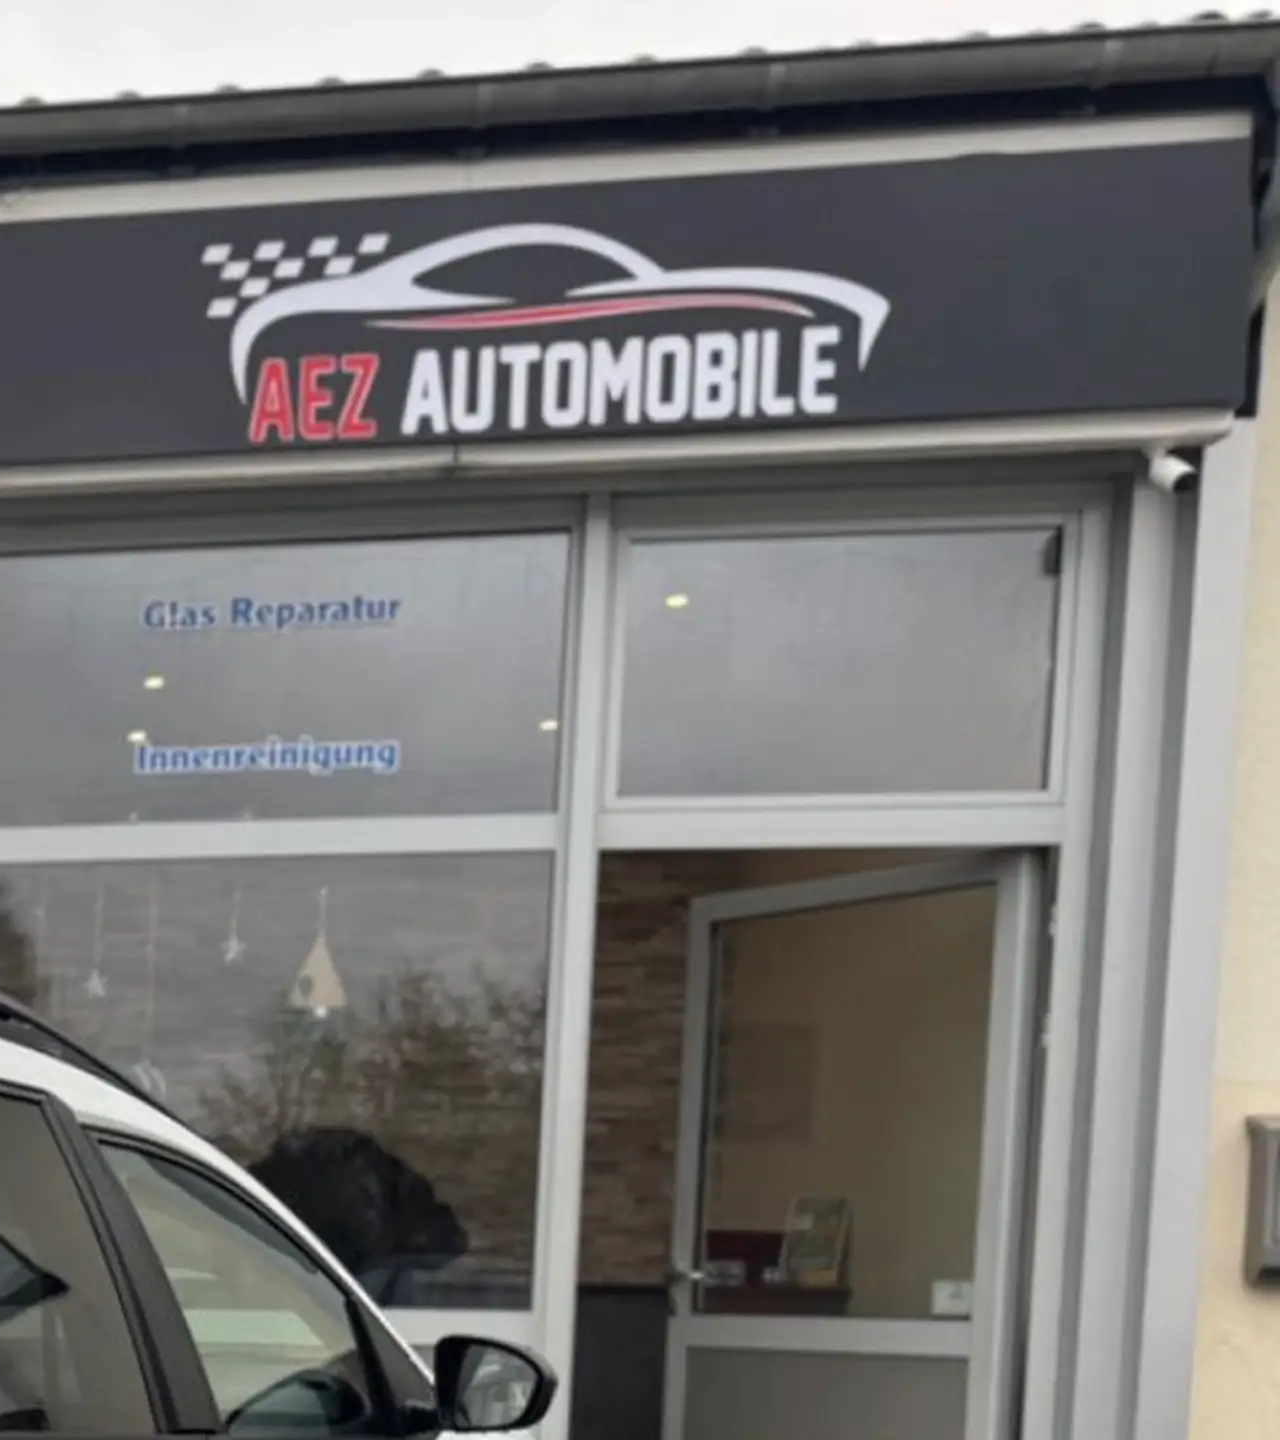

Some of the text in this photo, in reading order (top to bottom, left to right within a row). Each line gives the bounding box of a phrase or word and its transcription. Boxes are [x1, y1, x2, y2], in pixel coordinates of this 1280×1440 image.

[248, 326, 841, 443] AEZ AUTOMOBILE
[229, 595, 402, 632] Reparatur
[137, 738, 401, 776] Innenreinigung
